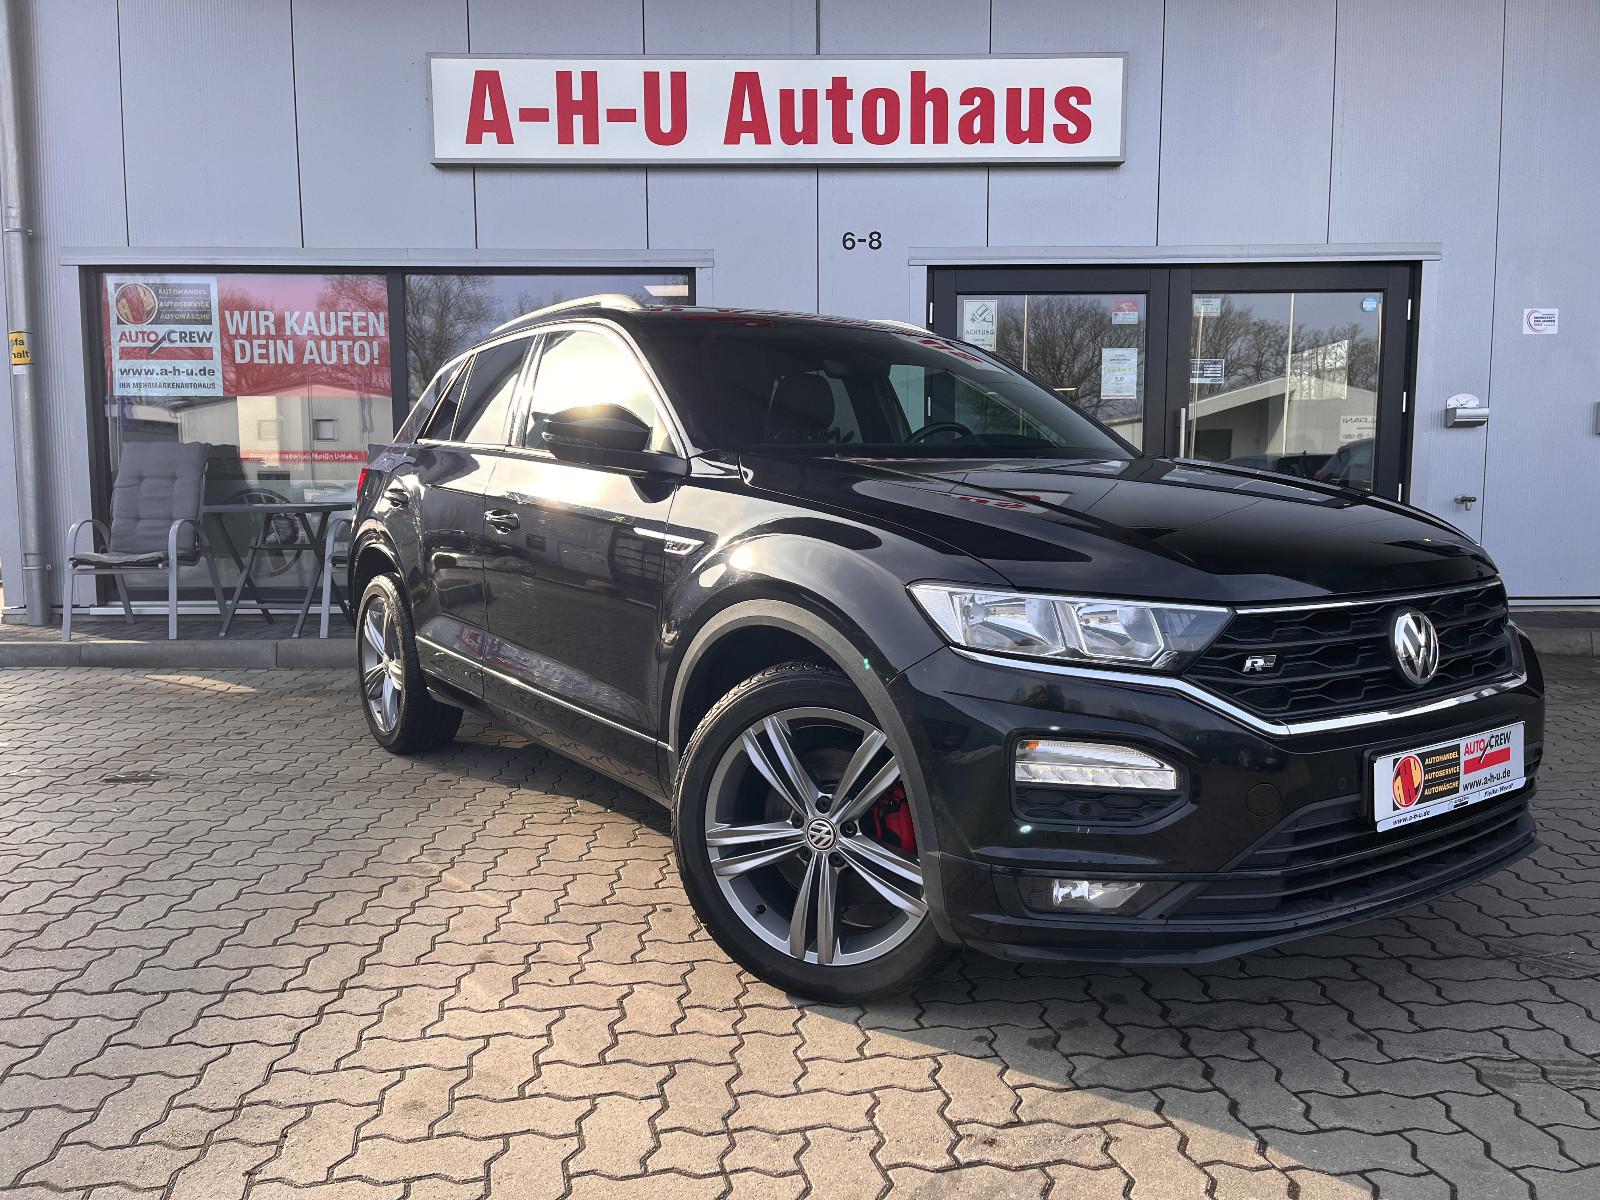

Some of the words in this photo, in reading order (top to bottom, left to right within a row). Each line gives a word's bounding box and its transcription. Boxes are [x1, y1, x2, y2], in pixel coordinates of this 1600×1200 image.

[465, 70, 687, 146] A-H-U
[723, 70, 1093, 146] Autohaus
[842, 231, 882, 250] 6-8
[159, 300, 210, 308] AUTOSERVICE
[225, 310, 276, 336] WIR
[284, 311, 385, 337] KAUFEN
[234, 339, 295, 364] DEIN
[302, 340, 380, 365] AUTO!
[119, 365, 216, 377] www.a-h-u.de
[132, 382, 216, 390] MEHRMARKENAUTOHAUS
[1424, 750, 1459, 766] AUTOHANDEL
[1424, 765, 1460, 781] AUTOSERVICE
[1462, 767, 1511, 792] www.a-h-u.de
[1392, 809, 1431, 826] www.a-h-u.de
